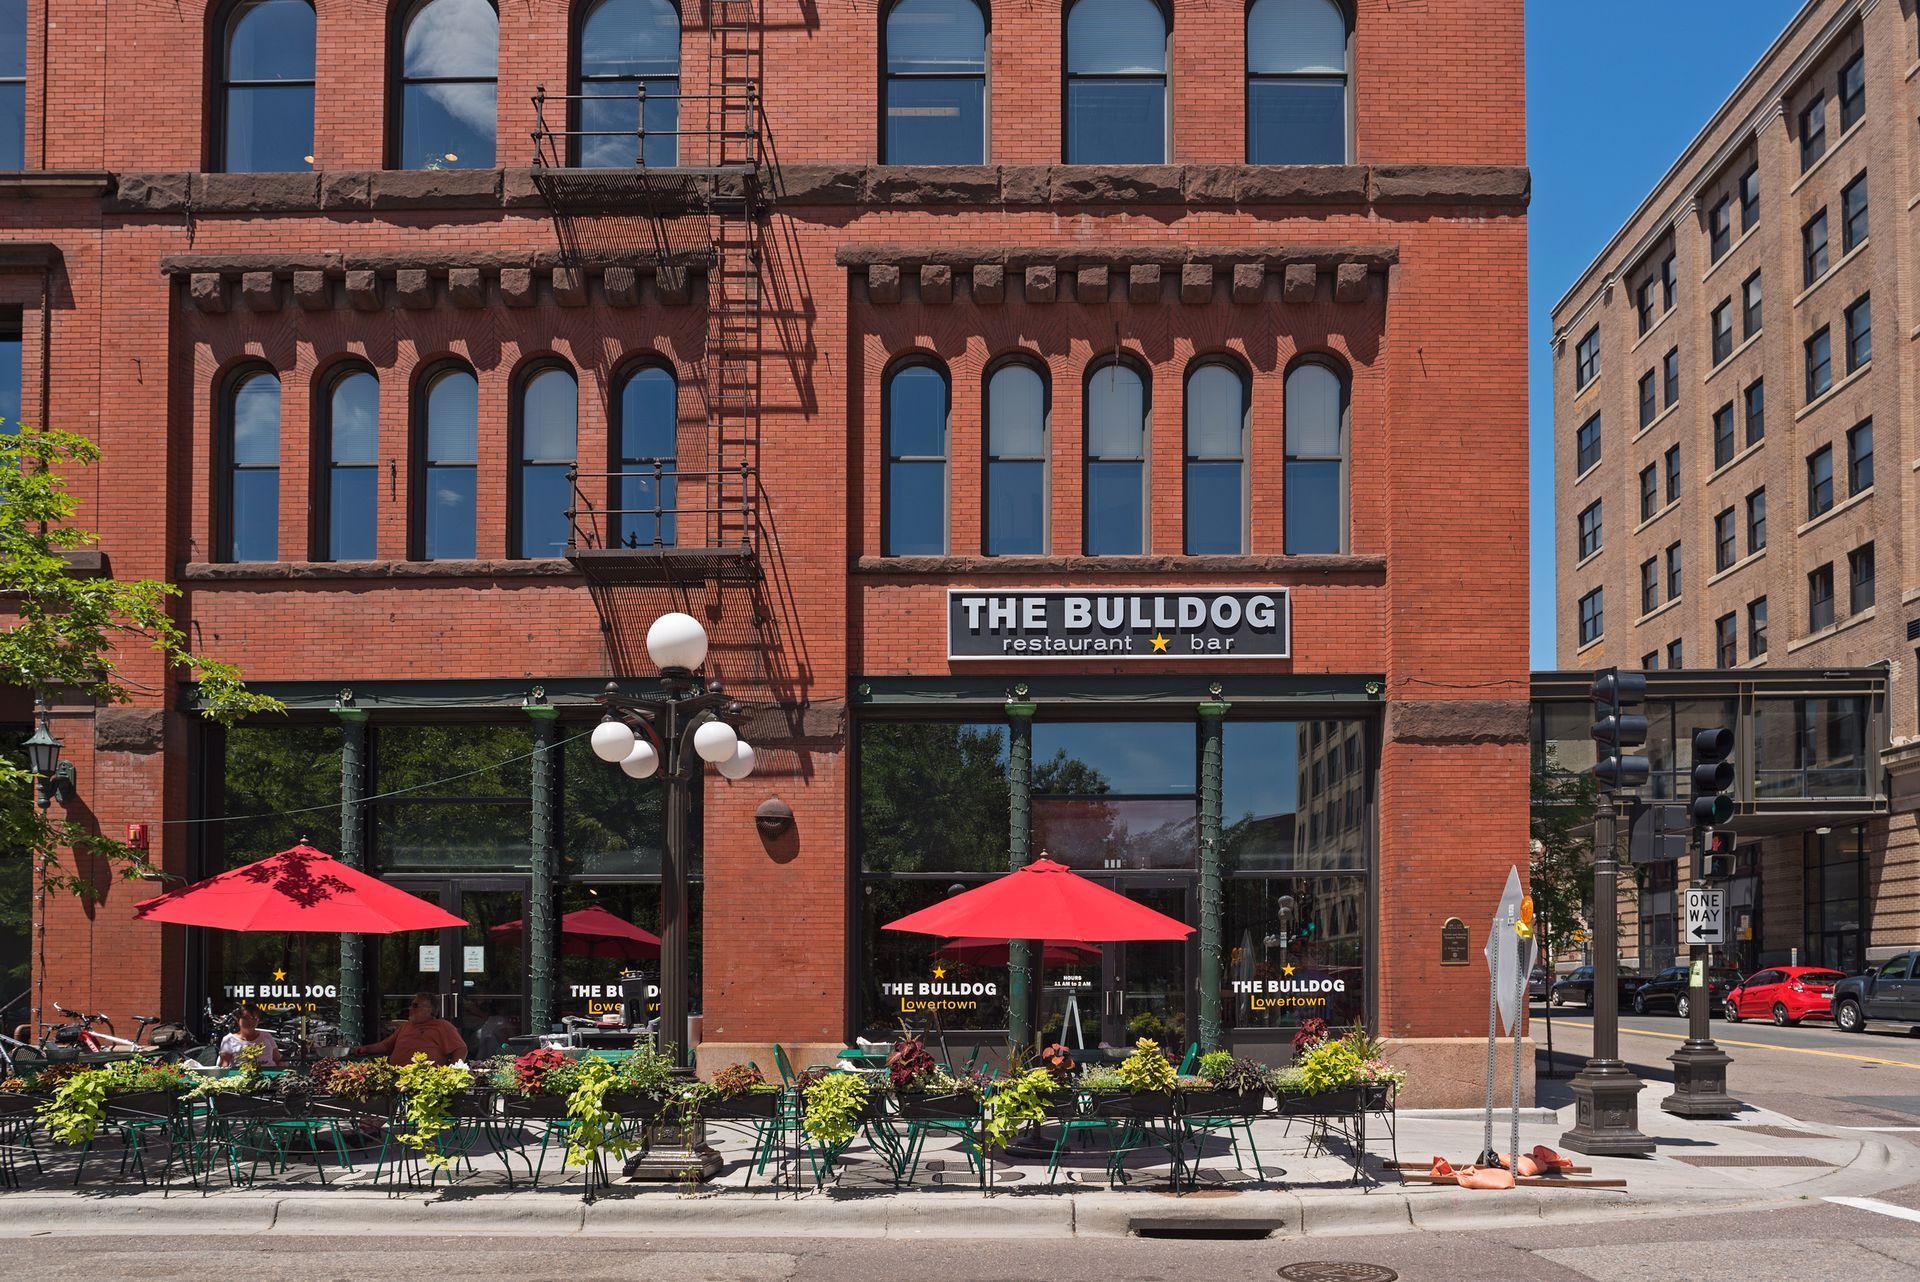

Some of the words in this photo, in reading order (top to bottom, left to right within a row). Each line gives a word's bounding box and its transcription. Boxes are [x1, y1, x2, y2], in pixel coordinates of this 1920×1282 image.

[962, 597, 1048, 629] THE
[1064, 595, 1276, 629] BULLDOG
[1003, 635, 1132, 651] restaurant
[1191, 634, 1235, 650] bar
[1690, 894, 1719, 907] ONE
[1689, 909, 1720, 922] WAY
[224, 985, 255, 998] THE
[570, 985, 601, 998] THE
[882, 983, 914, 996] THE
[919, 982, 997, 996] BULLDOG
[1232, 980, 1263, 993] THE
[1268, 979, 1345, 993] BULLDOG
[588, 999, 661, 1015] Lowew
[901, 997, 977, 1013] Lowertown
[1251, 995, 1326, 1010] Lowertown
